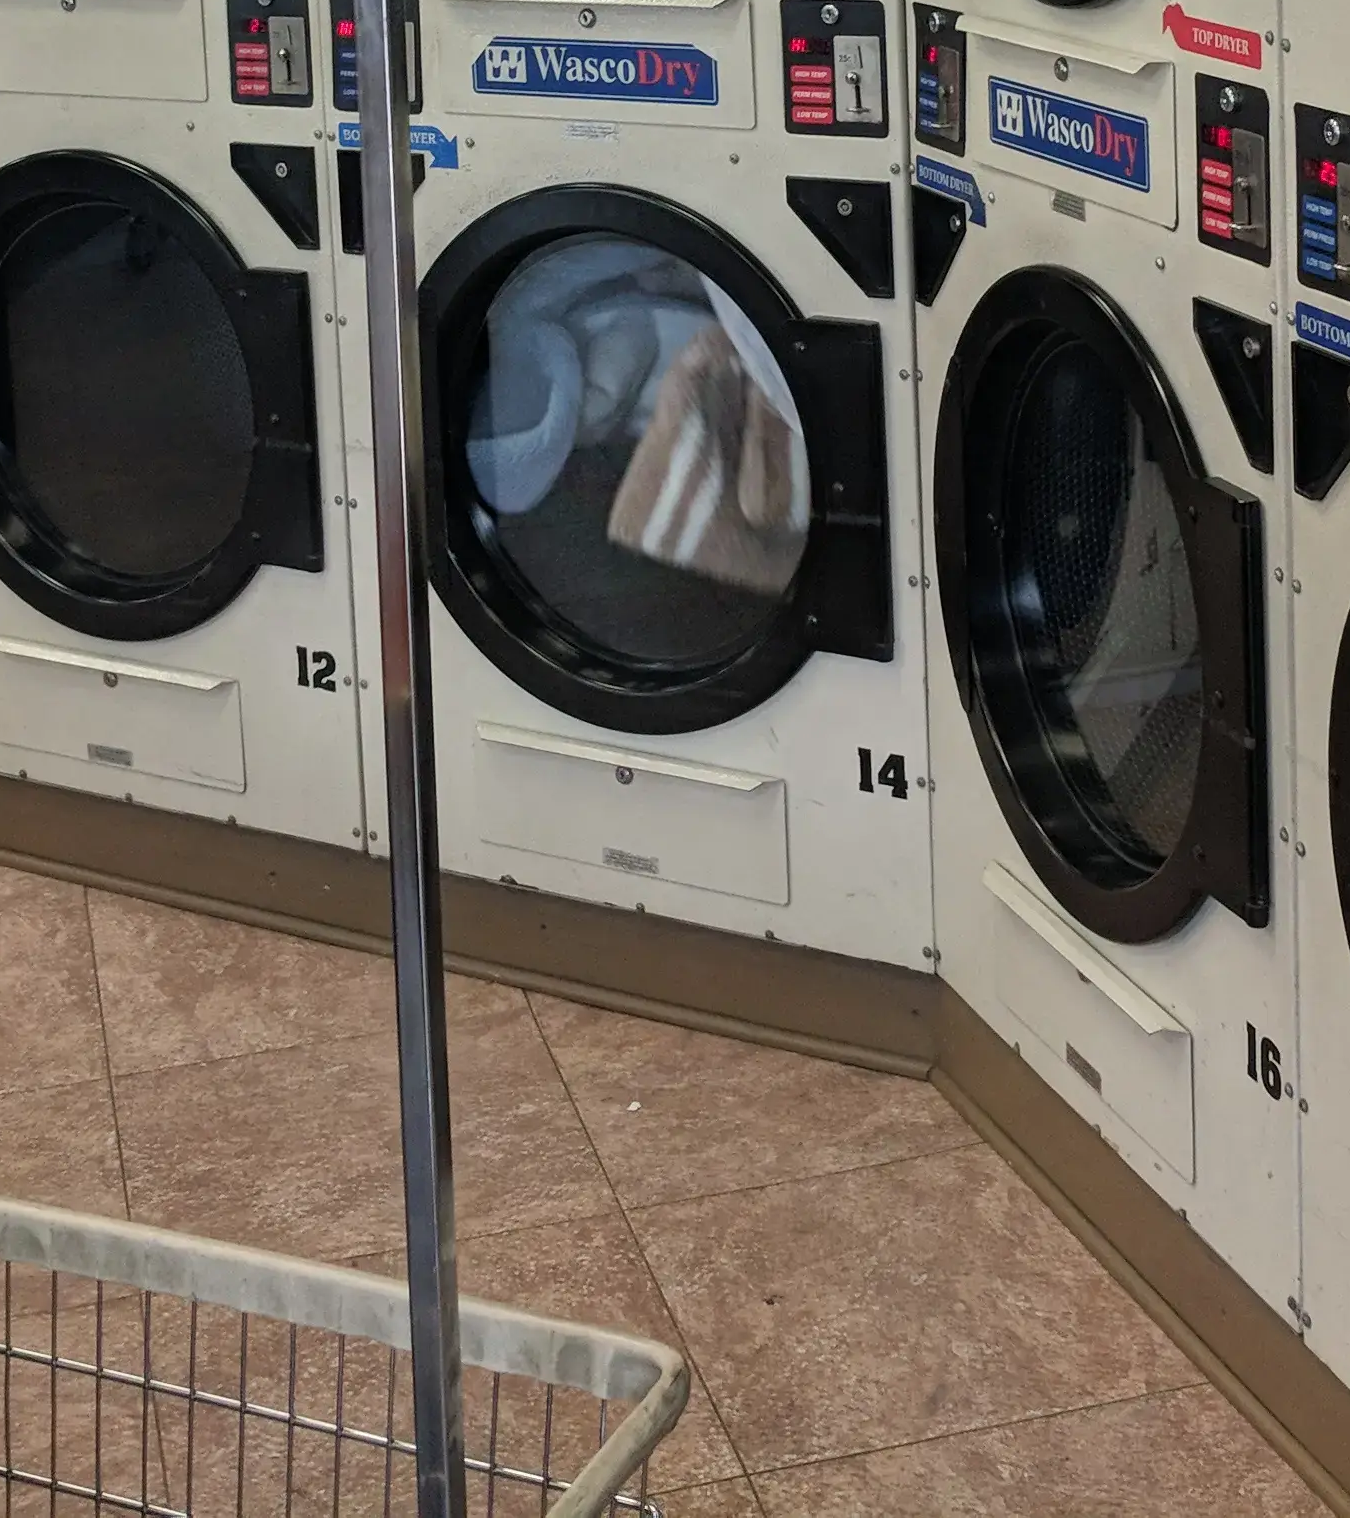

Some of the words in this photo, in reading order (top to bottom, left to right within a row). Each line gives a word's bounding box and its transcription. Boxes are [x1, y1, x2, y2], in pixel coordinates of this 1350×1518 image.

[1192, 28, 1213, 46] TOP
[1215, 33, 1249, 55] DRYER
[532, 45, 700, 96] WascoDry
[1026, 95, 1137, 176] WascoDry
[919, 164, 949, 188] BOTTOM
[296, 645, 337, 692] 12
[858, 747, 908, 799] 14
[1246, 1020, 1282, 1100] 16
